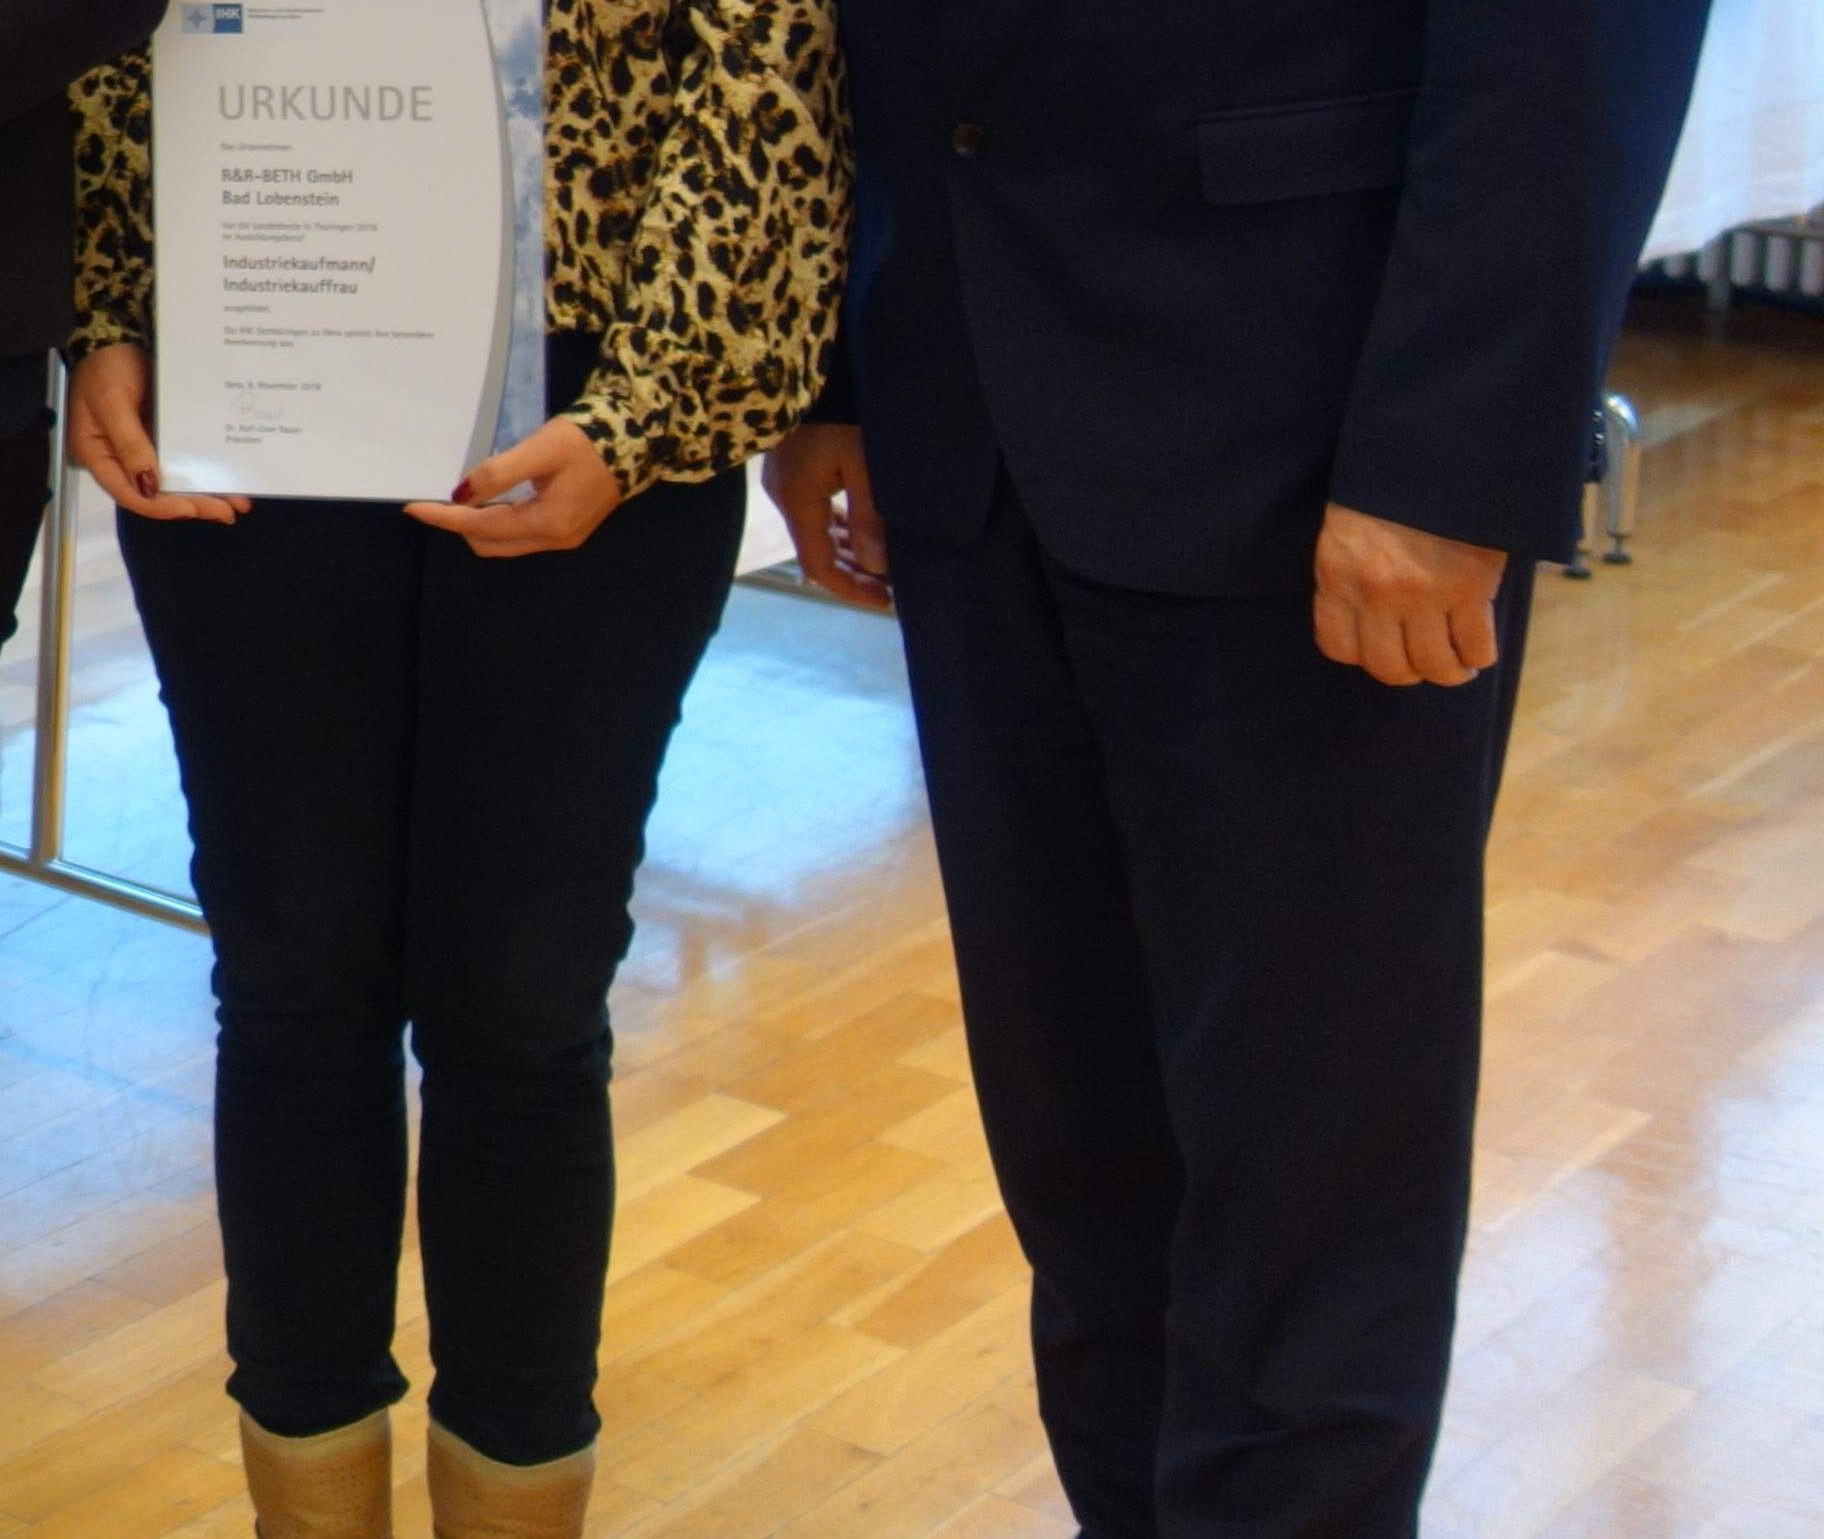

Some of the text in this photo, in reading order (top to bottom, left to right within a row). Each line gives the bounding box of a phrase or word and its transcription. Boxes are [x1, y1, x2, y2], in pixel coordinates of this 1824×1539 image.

[217, 84, 434, 122] URKUNDE
[221, 167, 353, 184] R&R-BETH GmbH
[222, 190, 341, 206] Bad Lobenstein
[223, 254, 377, 274] Industriekaufmann/
[223, 277, 359, 295] Industriekauffrau
